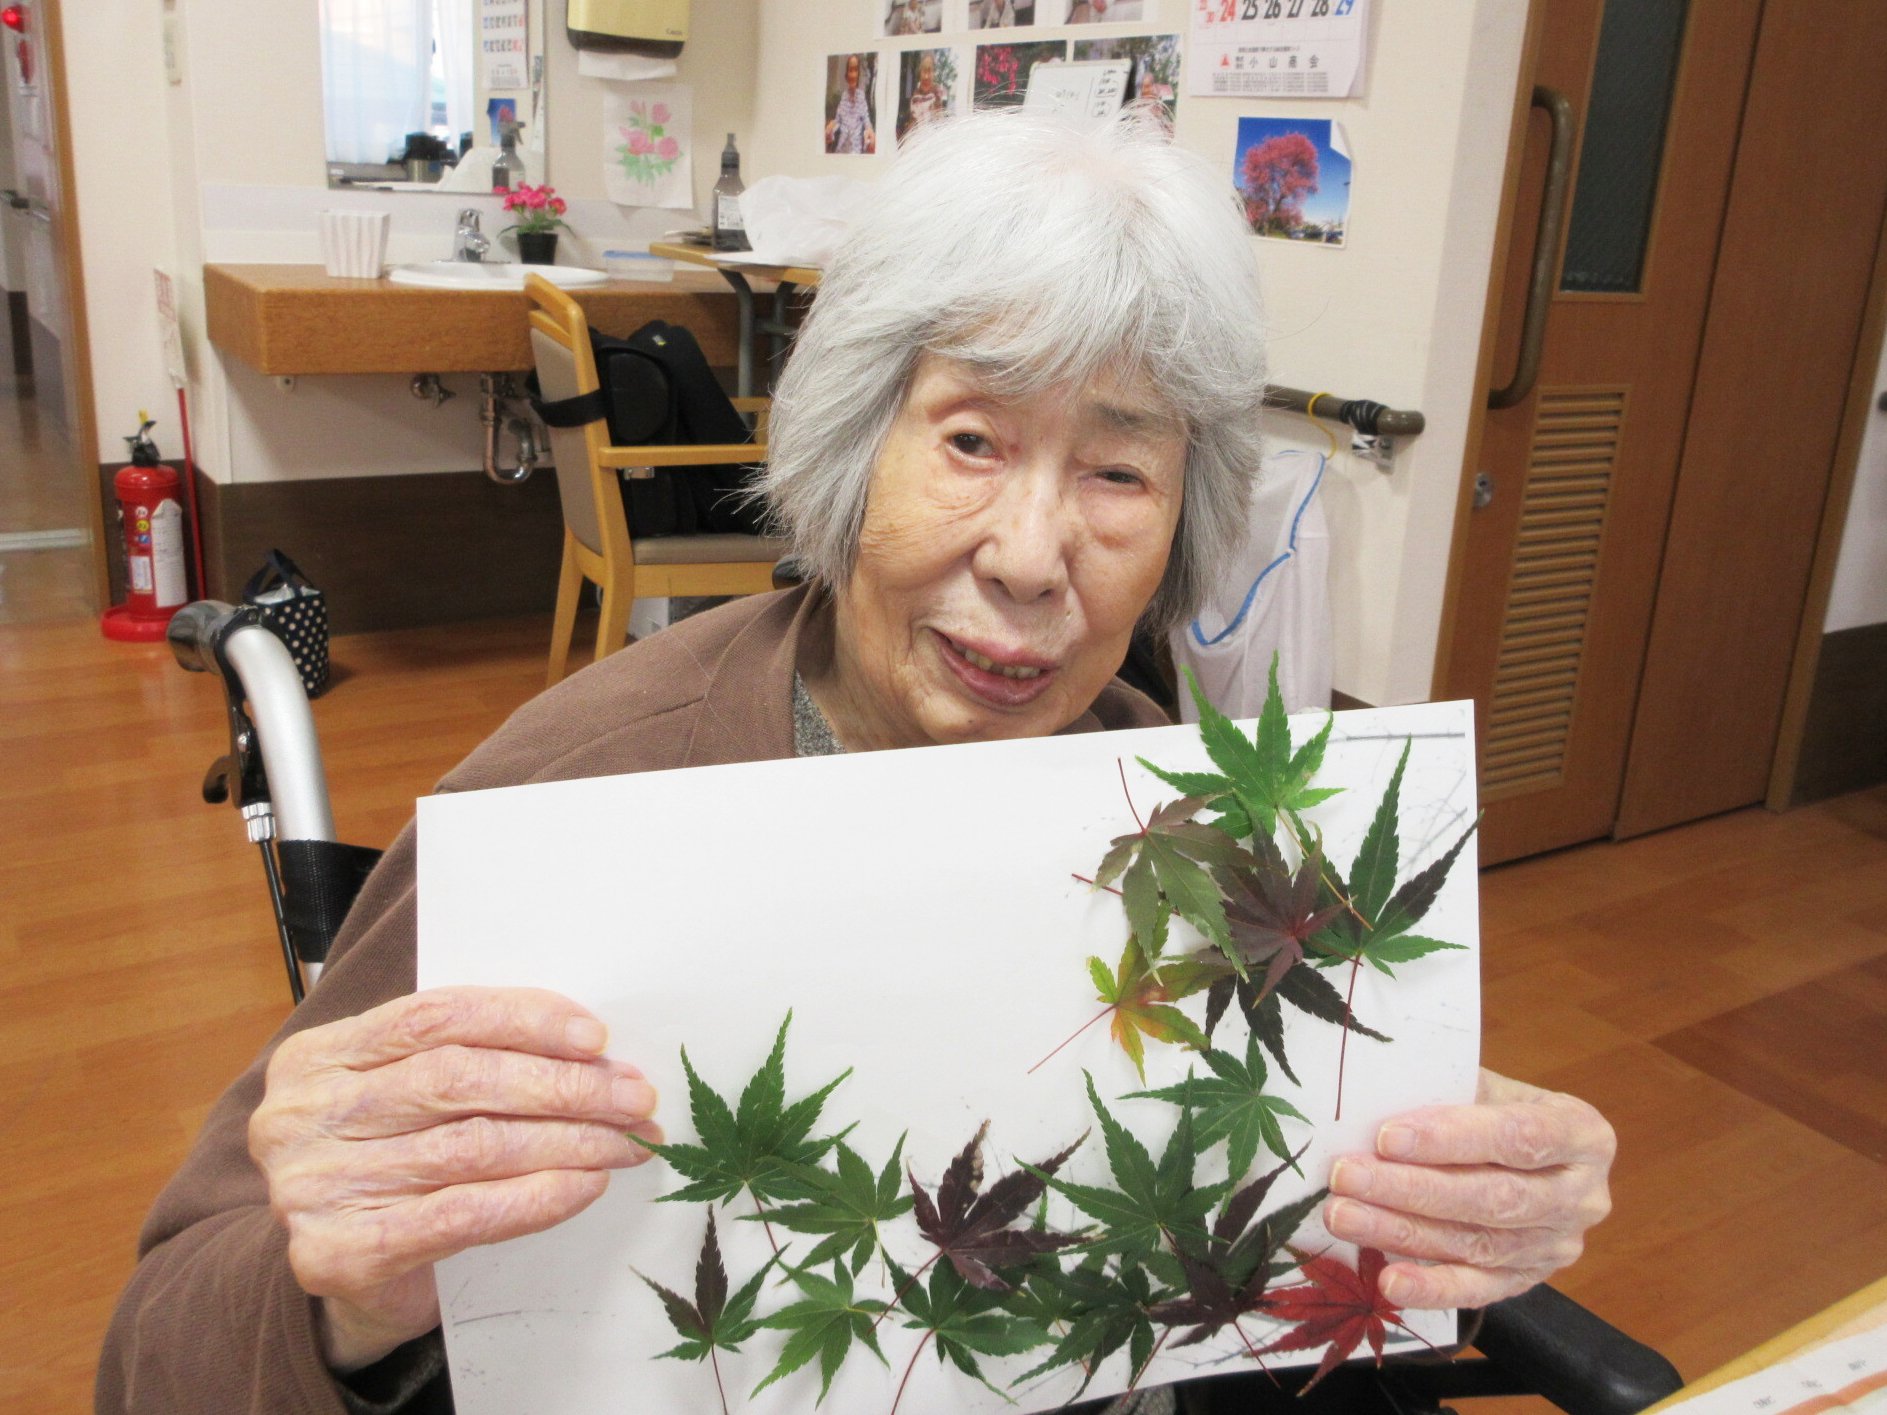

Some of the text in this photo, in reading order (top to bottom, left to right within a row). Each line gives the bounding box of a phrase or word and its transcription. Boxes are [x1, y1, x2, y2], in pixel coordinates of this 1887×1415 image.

[1241, 0, 1259, 20] 25
[1264, 0, 1282, 19] 26
[1287, 0, 1304, 18] 27
[1311, 0, 1329, 17] 28
